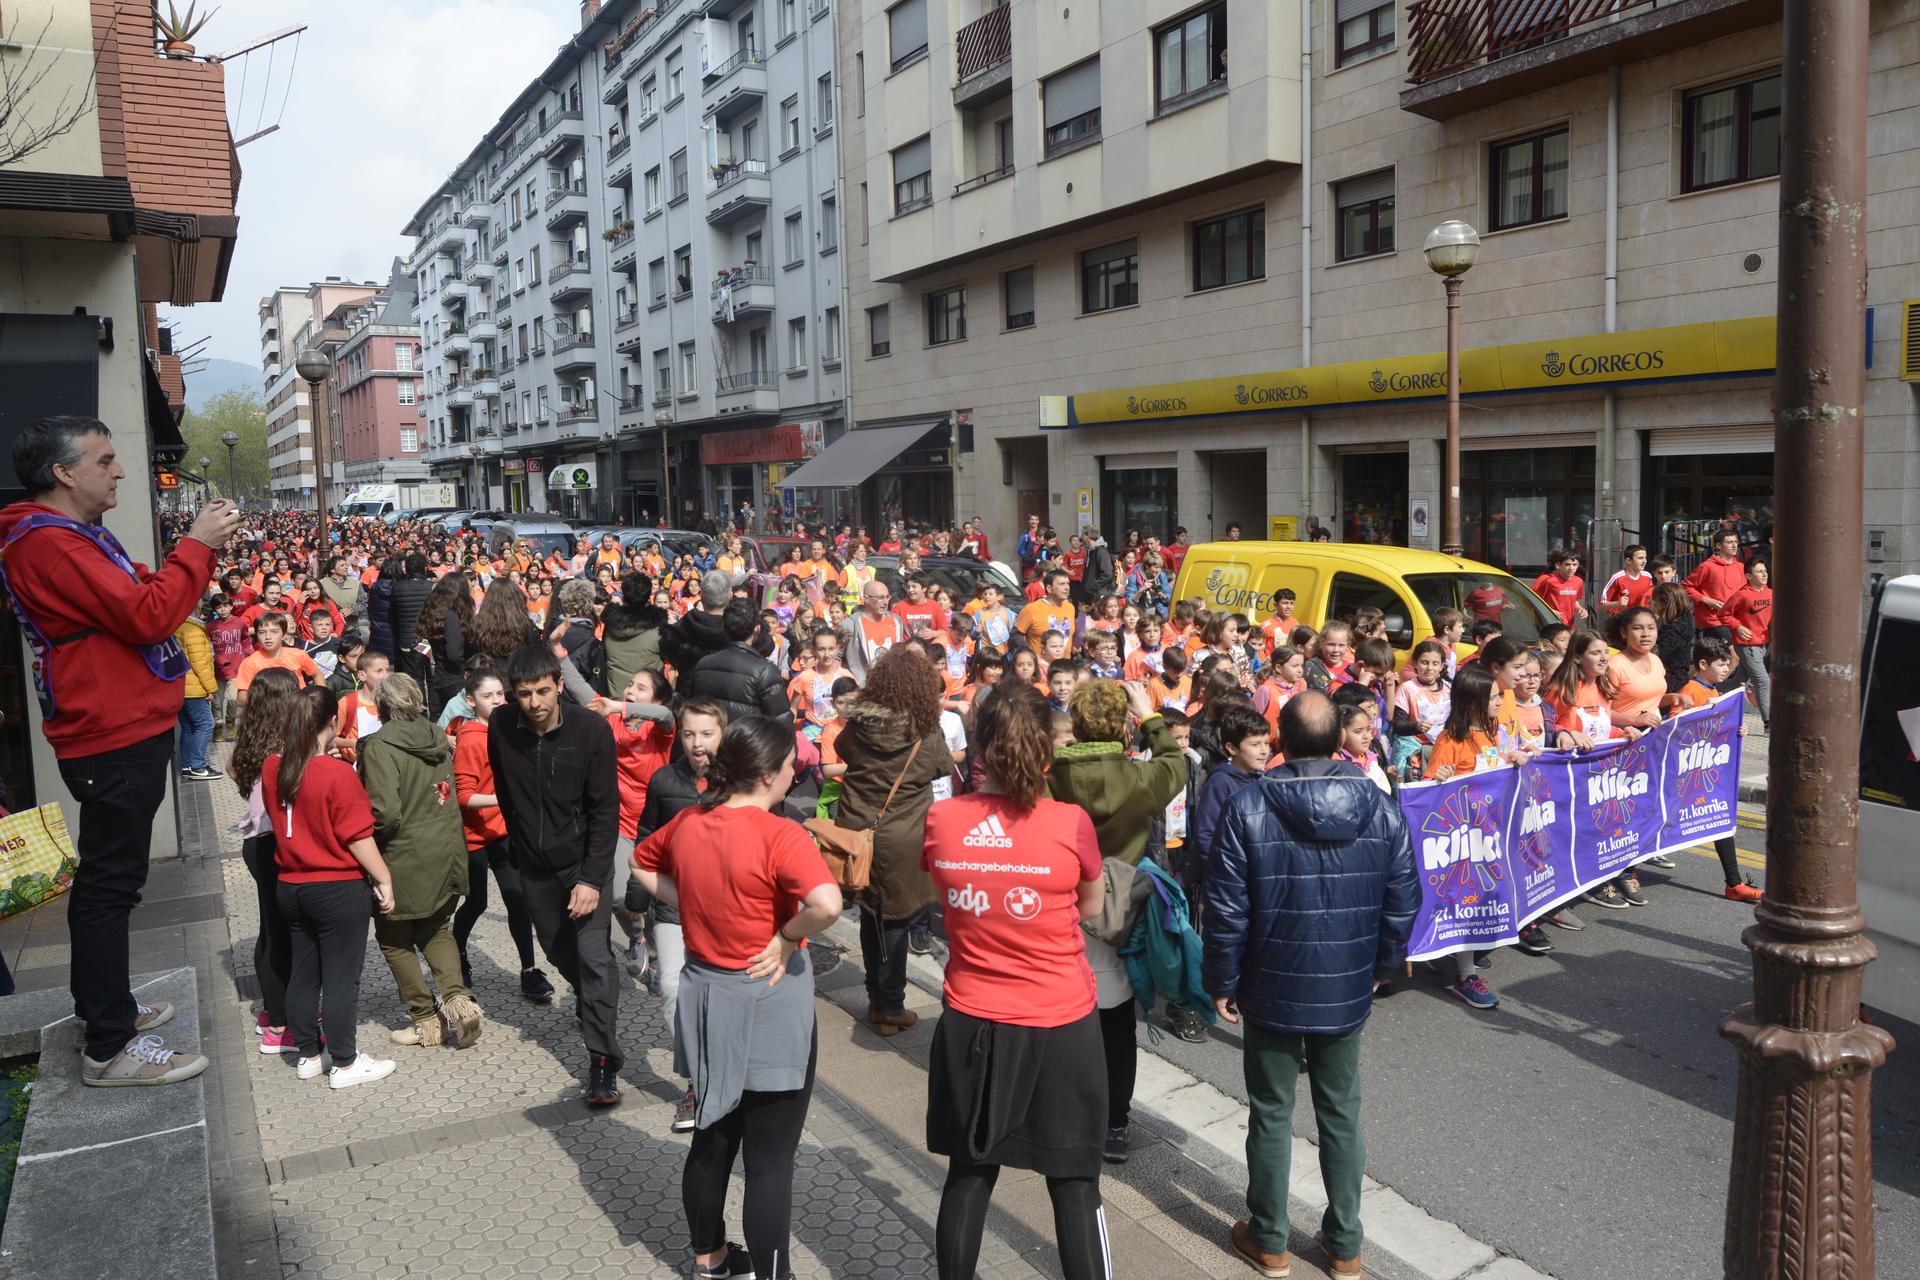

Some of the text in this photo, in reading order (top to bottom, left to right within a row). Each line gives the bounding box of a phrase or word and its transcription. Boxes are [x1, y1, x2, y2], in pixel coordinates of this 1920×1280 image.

[1569, 350, 1664, 376] CORREOS
[1251, 385, 1308, 404] CORREOS
[1140, 398, 1186, 413] CORREOS
[1679, 799, 1728, 821] 21. korrika
[963, 834, 1013, 848] adidas
[1597, 840, 1610, 855] 21.
[1609, 830, 1639, 851] korrika
[947, 883, 990, 918] edp
[1455, 900, 1510, 919] korrika
[1438, 924, 1510, 940] GARESTIK GASTEIZA
